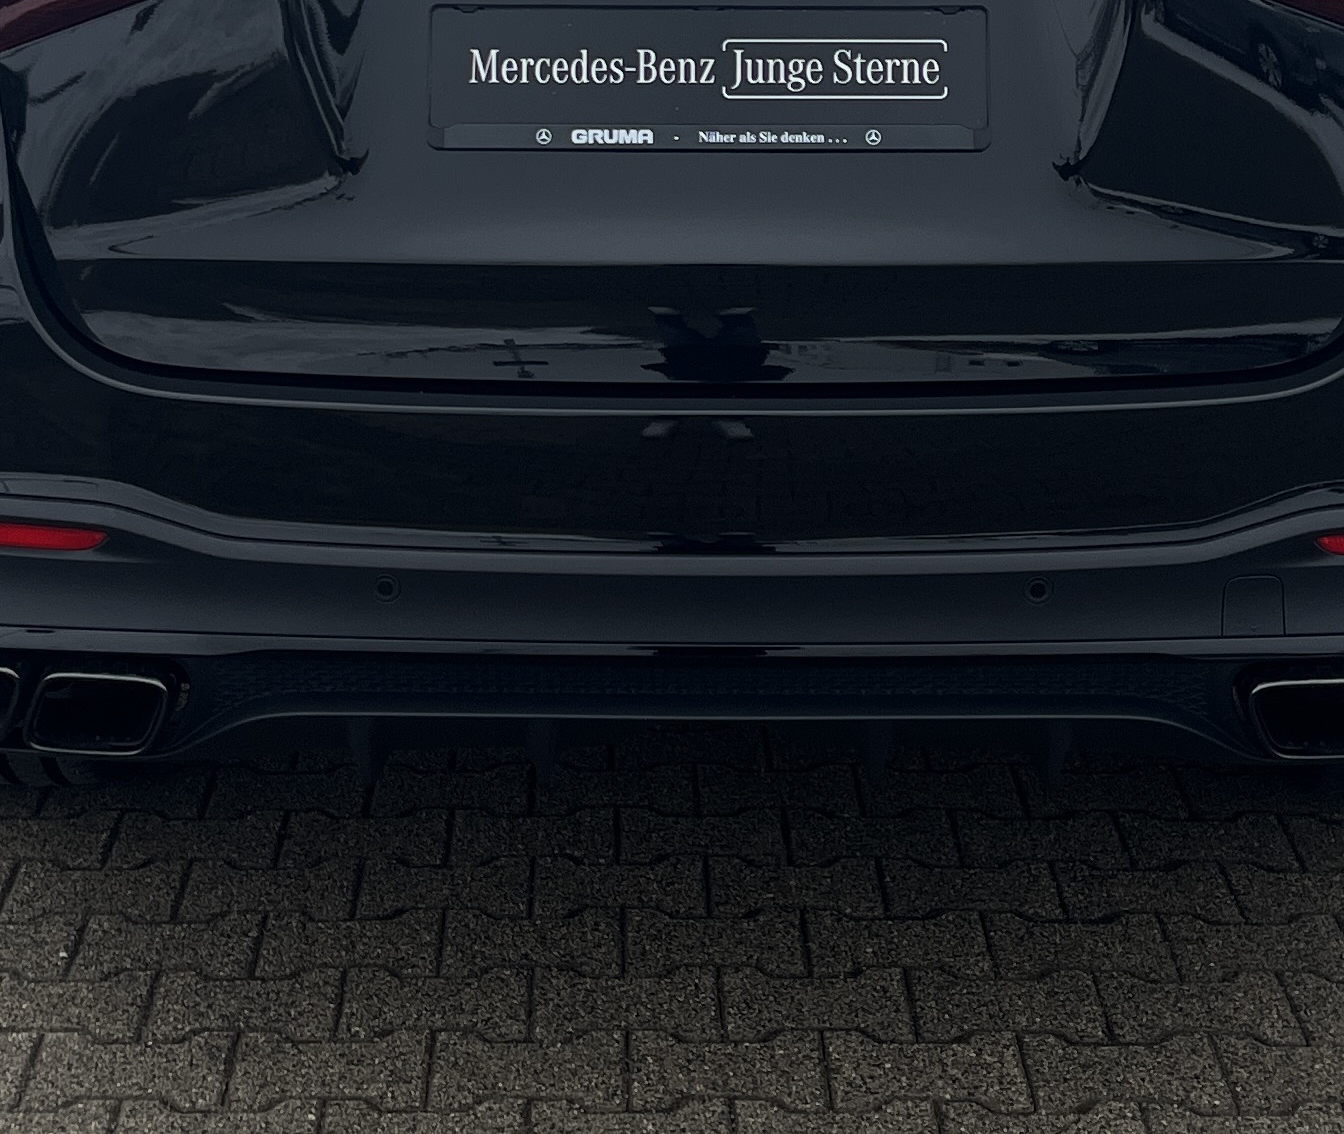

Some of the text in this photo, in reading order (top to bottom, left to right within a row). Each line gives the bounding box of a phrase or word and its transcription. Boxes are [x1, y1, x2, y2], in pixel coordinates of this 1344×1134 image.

[469, 48, 941, 93] Mercedes-Benz Junge Sterne
[571, 128, 654, 145] GRUMA
[698, 130, 737, 144] Näher
[739, 130, 757, 144] als
[758, 130, 778, 144] Sie
